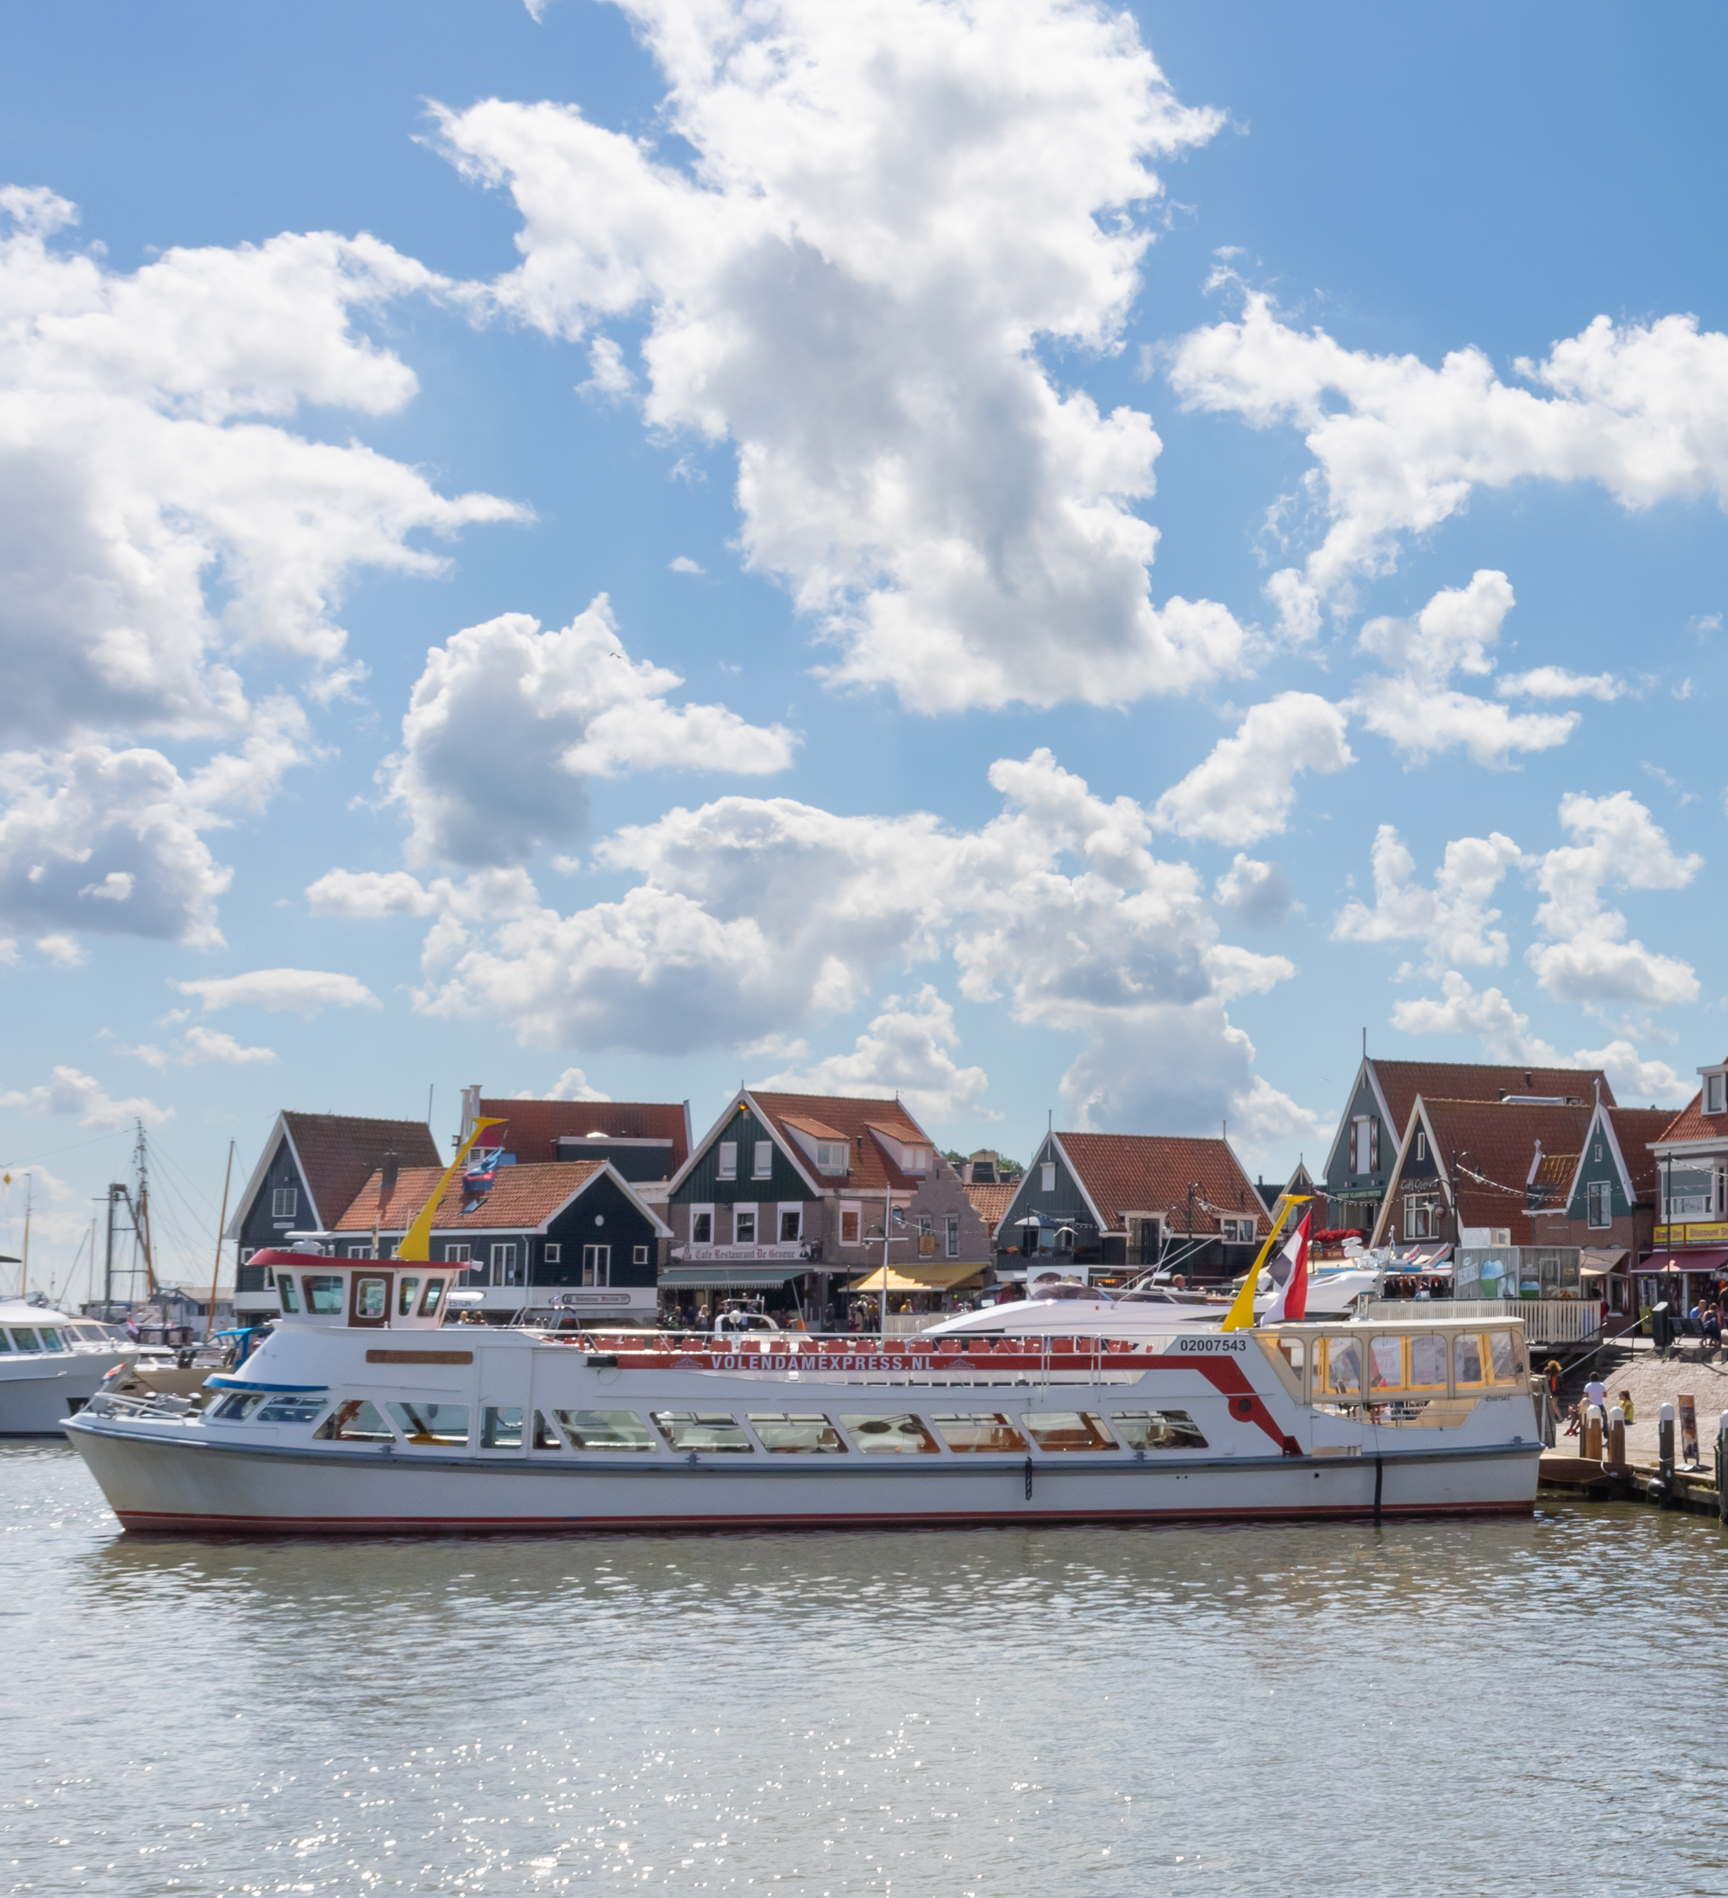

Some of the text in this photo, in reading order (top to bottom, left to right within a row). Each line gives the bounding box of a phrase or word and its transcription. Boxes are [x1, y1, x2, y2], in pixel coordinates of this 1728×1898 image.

[1690, 1227, 1719, 1237] Discount
[1180, 1339, 1247, 1351] 02007543
[711, 1355, 935, 1370] VOLENDAMEXPRESS.NL
